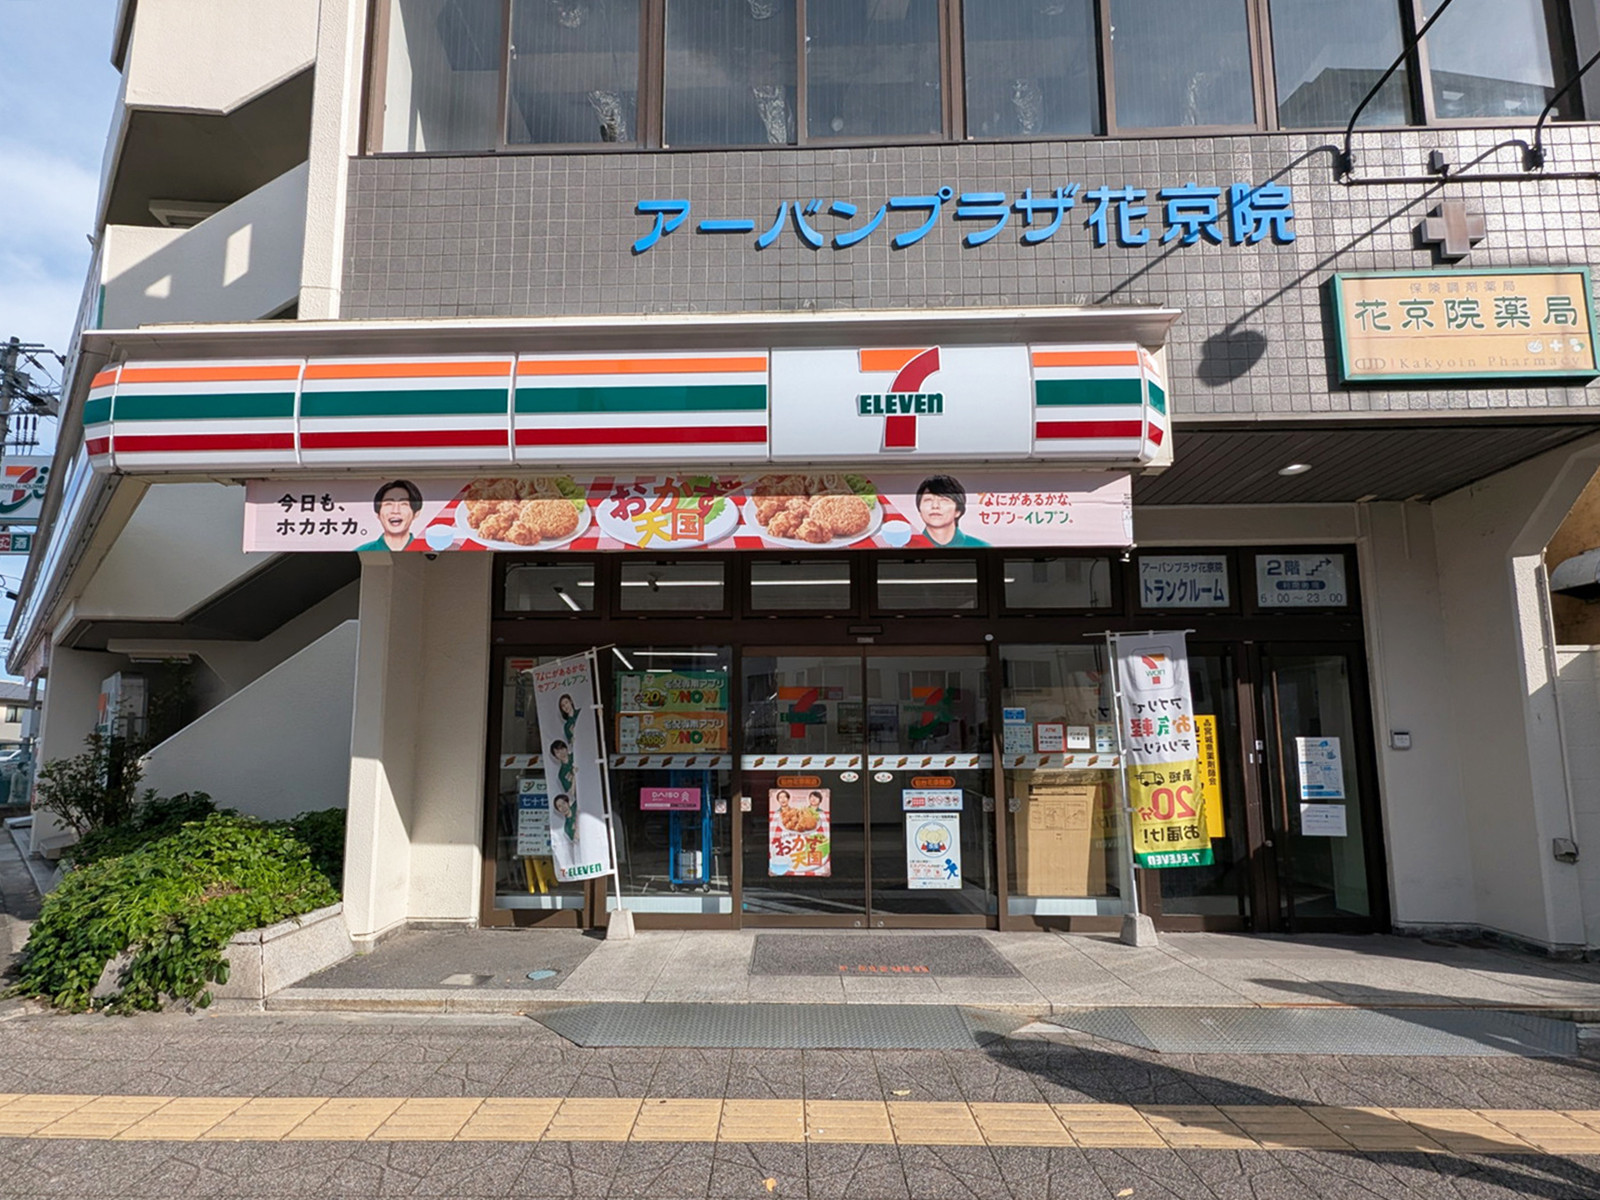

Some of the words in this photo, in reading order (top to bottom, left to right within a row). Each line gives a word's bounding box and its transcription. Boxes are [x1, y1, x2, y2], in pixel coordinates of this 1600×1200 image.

[633, 182, 1296, 254] アーバンプラザ花京院
[1410, 280, 1516, 294] 保険調剤薬局
[1354, 296, 1578, 331] 花京院薬局
[1400, 357, 1477, 371] Kakyoin
[1488, 355, 1580, 369] Pharmacy
[860, 347, 940, 448] 7
[277, 493, 346, 513] 今日も、
[609, 477, 742, 521] おかず
[276, 517, 368, 536] ホカホカ。
[631, 508, 705, 549] 天国
[14, 536, 28, 549] 酒
[1142, 561, 1224, 574] アーバンプラザ花京院
[1266, 559, 1300, 576] 2階
[1143, 577, 1225, 603] トランクルーム
[651, 791, 680, 799] DAISO
